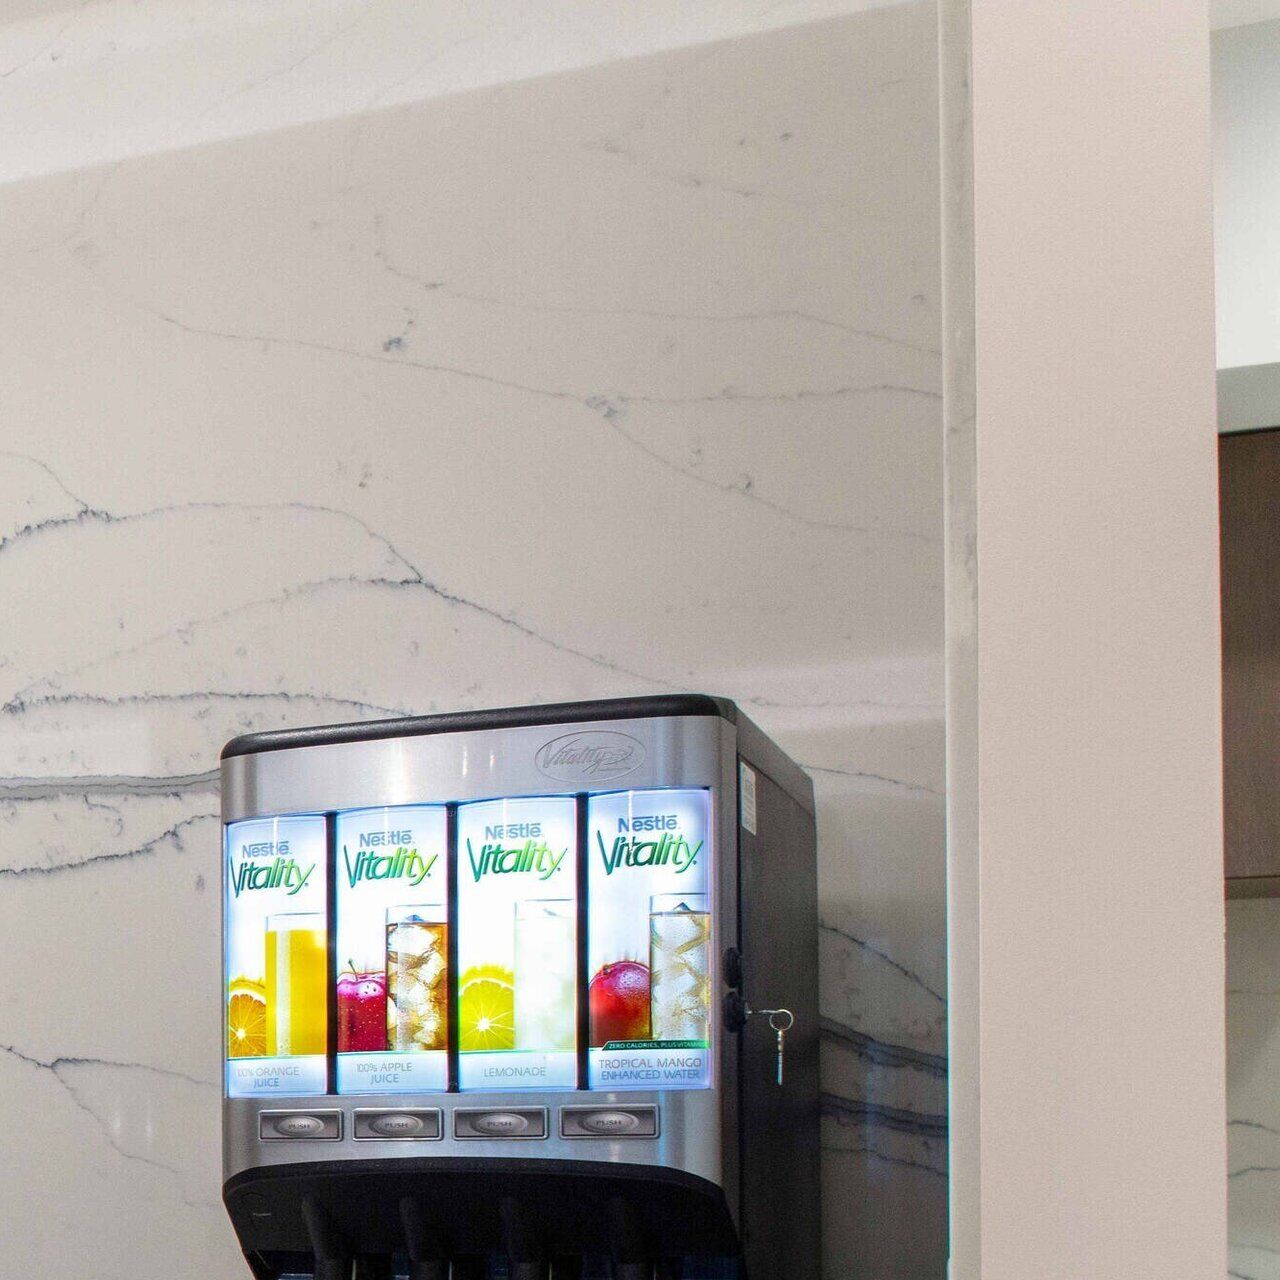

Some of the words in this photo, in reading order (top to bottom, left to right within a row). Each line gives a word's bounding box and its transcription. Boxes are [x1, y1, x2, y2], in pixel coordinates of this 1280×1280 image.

[597, 830, 704, 875] Vitality
[467, 838, 568, 883] Vitality
[343, 845, 438, 888] Vitality
[230, 856, 316, 898] Vitality
[356, 1064, 377, 1073] 100%
[380, 1062, 412, 1072] APPLE
[599, 1058, 652, 1069] TROPICAL
[657, 1057, 701, 1068] MANGO
[256, 1066, 300, 1076] ORANGE
[484, 1066, 546, 1077] LEMONADE
[601, 1070, 661, 1080] ENHANCED
[663, 1069, 700, 1079] WATER
[253, 1077, 279, 1088] JUICE
[371, 1073, 399, 1084] JUICE
